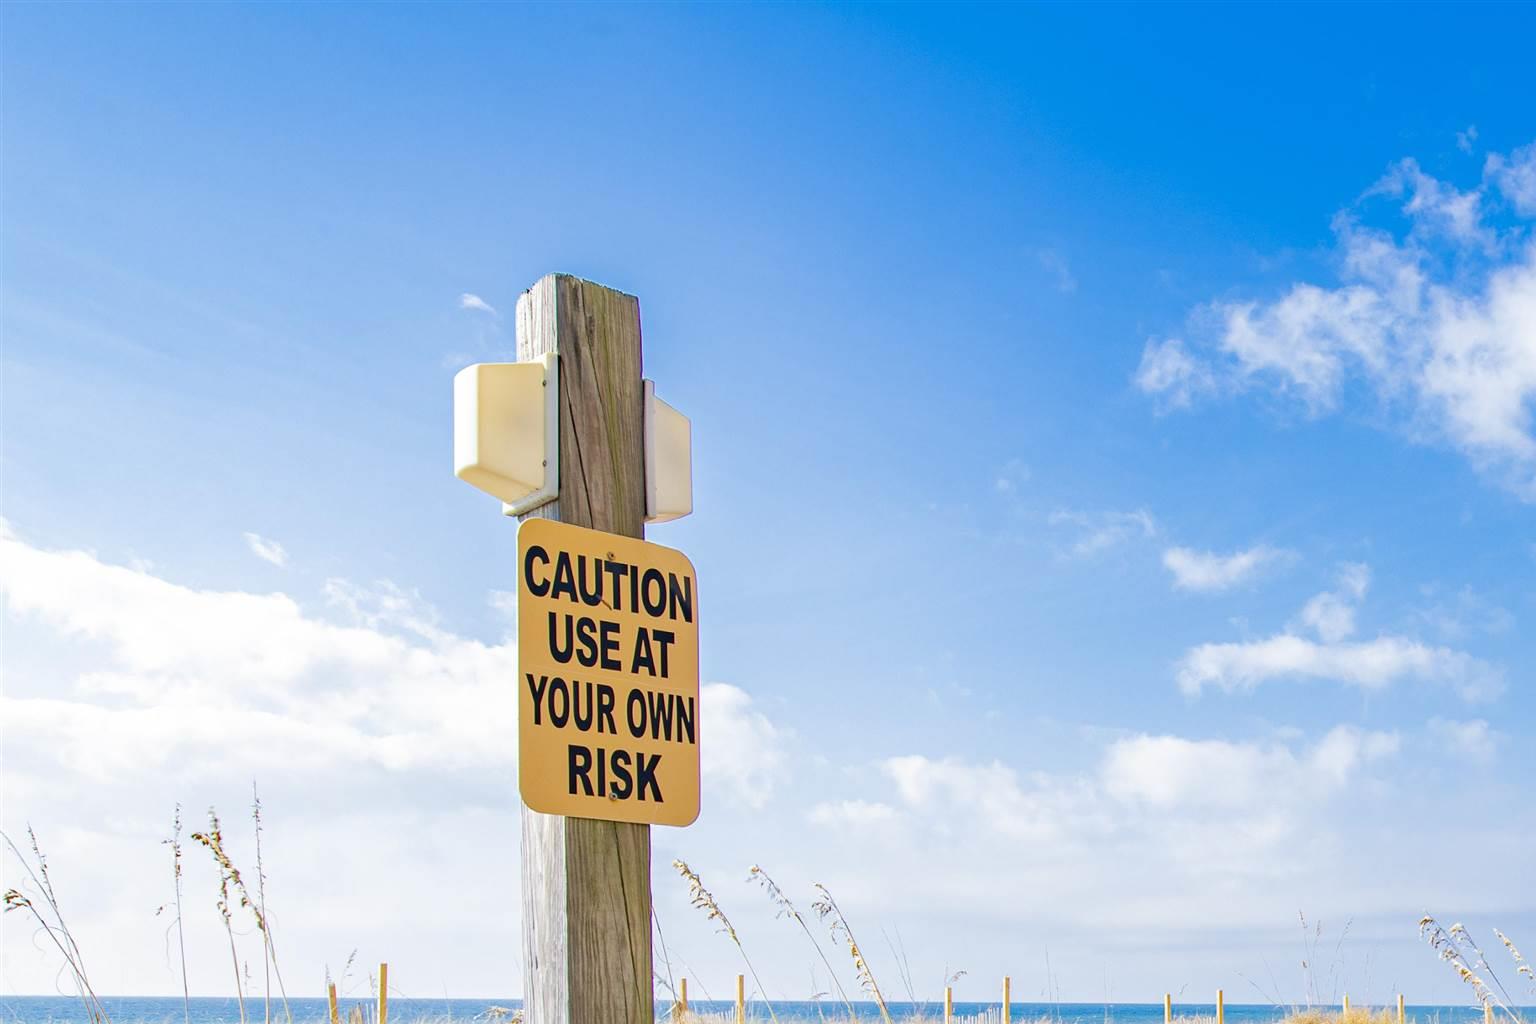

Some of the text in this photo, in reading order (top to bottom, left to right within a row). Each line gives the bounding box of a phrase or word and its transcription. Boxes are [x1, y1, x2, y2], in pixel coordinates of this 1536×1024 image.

[524, 545, 693, 624] CAUTION
[548, 612, 675, 679] USE AT
[526, 673, 695, 744] YOUR OWN
[568, 744, 664, 803] RISK
